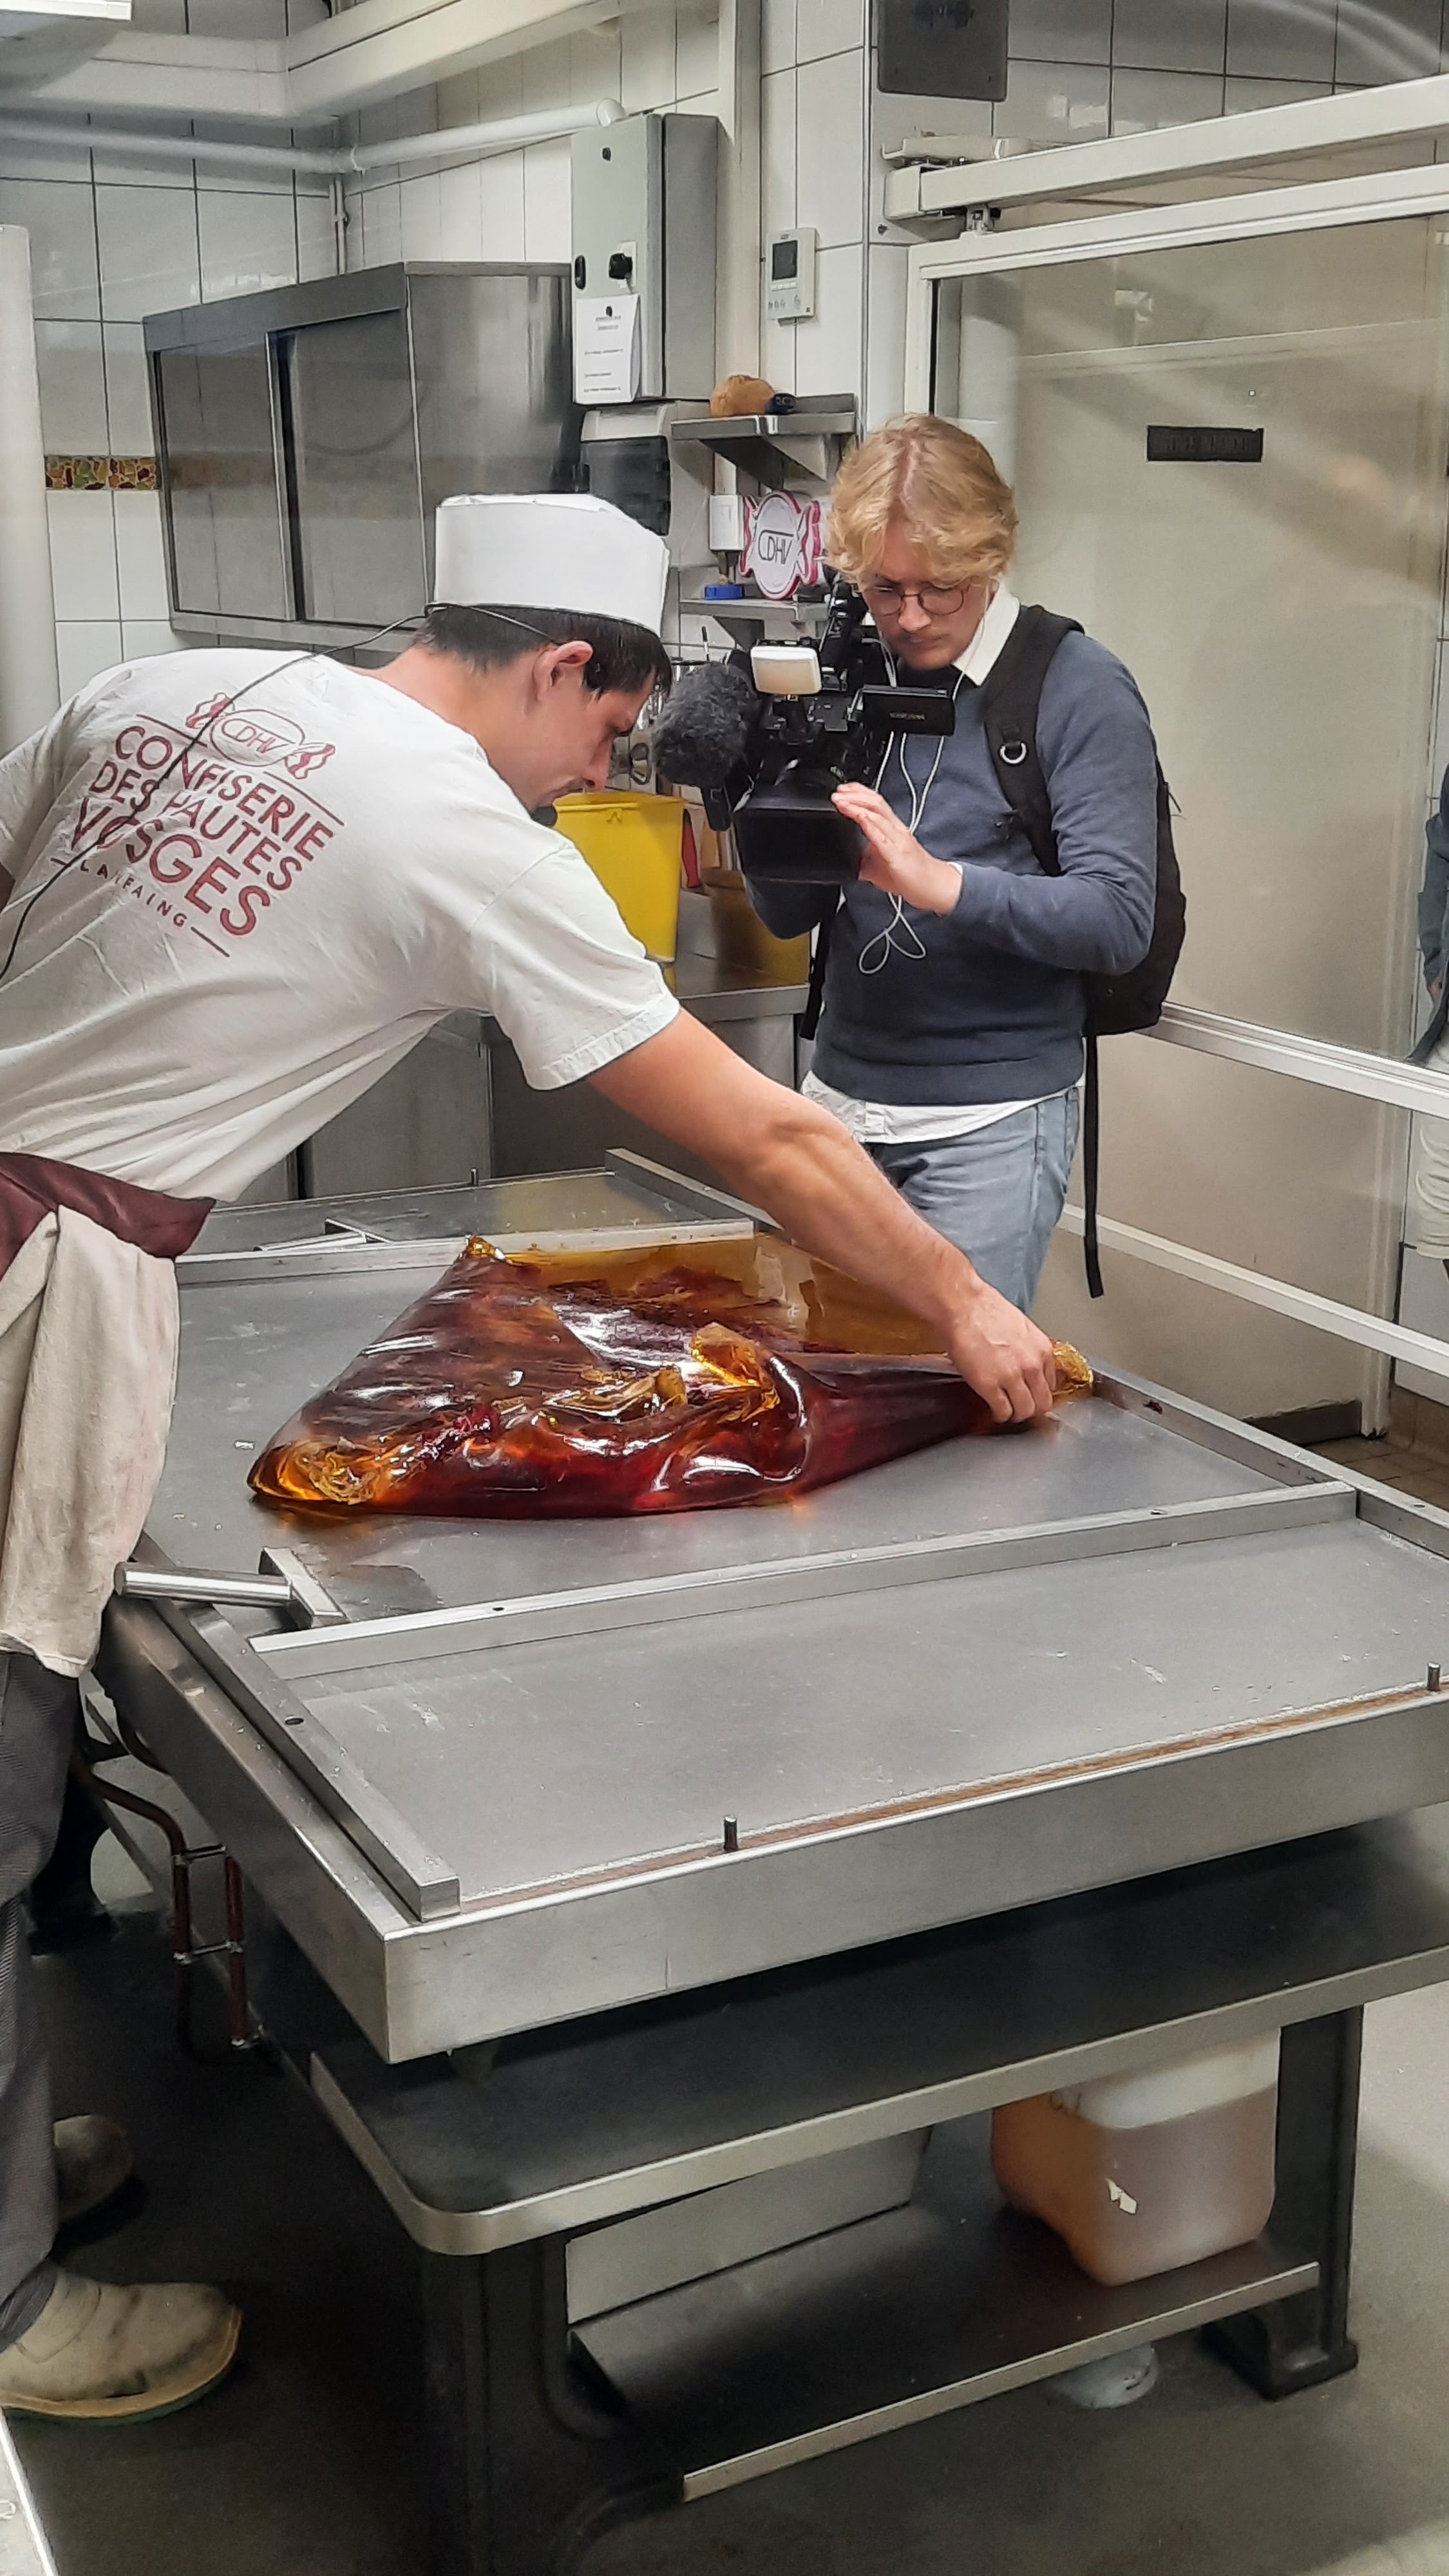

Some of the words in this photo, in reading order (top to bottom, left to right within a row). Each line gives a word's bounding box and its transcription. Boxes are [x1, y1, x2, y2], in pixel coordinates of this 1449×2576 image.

[758, 529, 794, 565] CDHV
[115, 726, 335, 862] CONFISERIE
[222, 719, 294, 753] CDHV
[71, 796, 270, 936] VOSGES
[88, 760, 156, 812] DES
[156, 790, 302, 891] HAUTES
